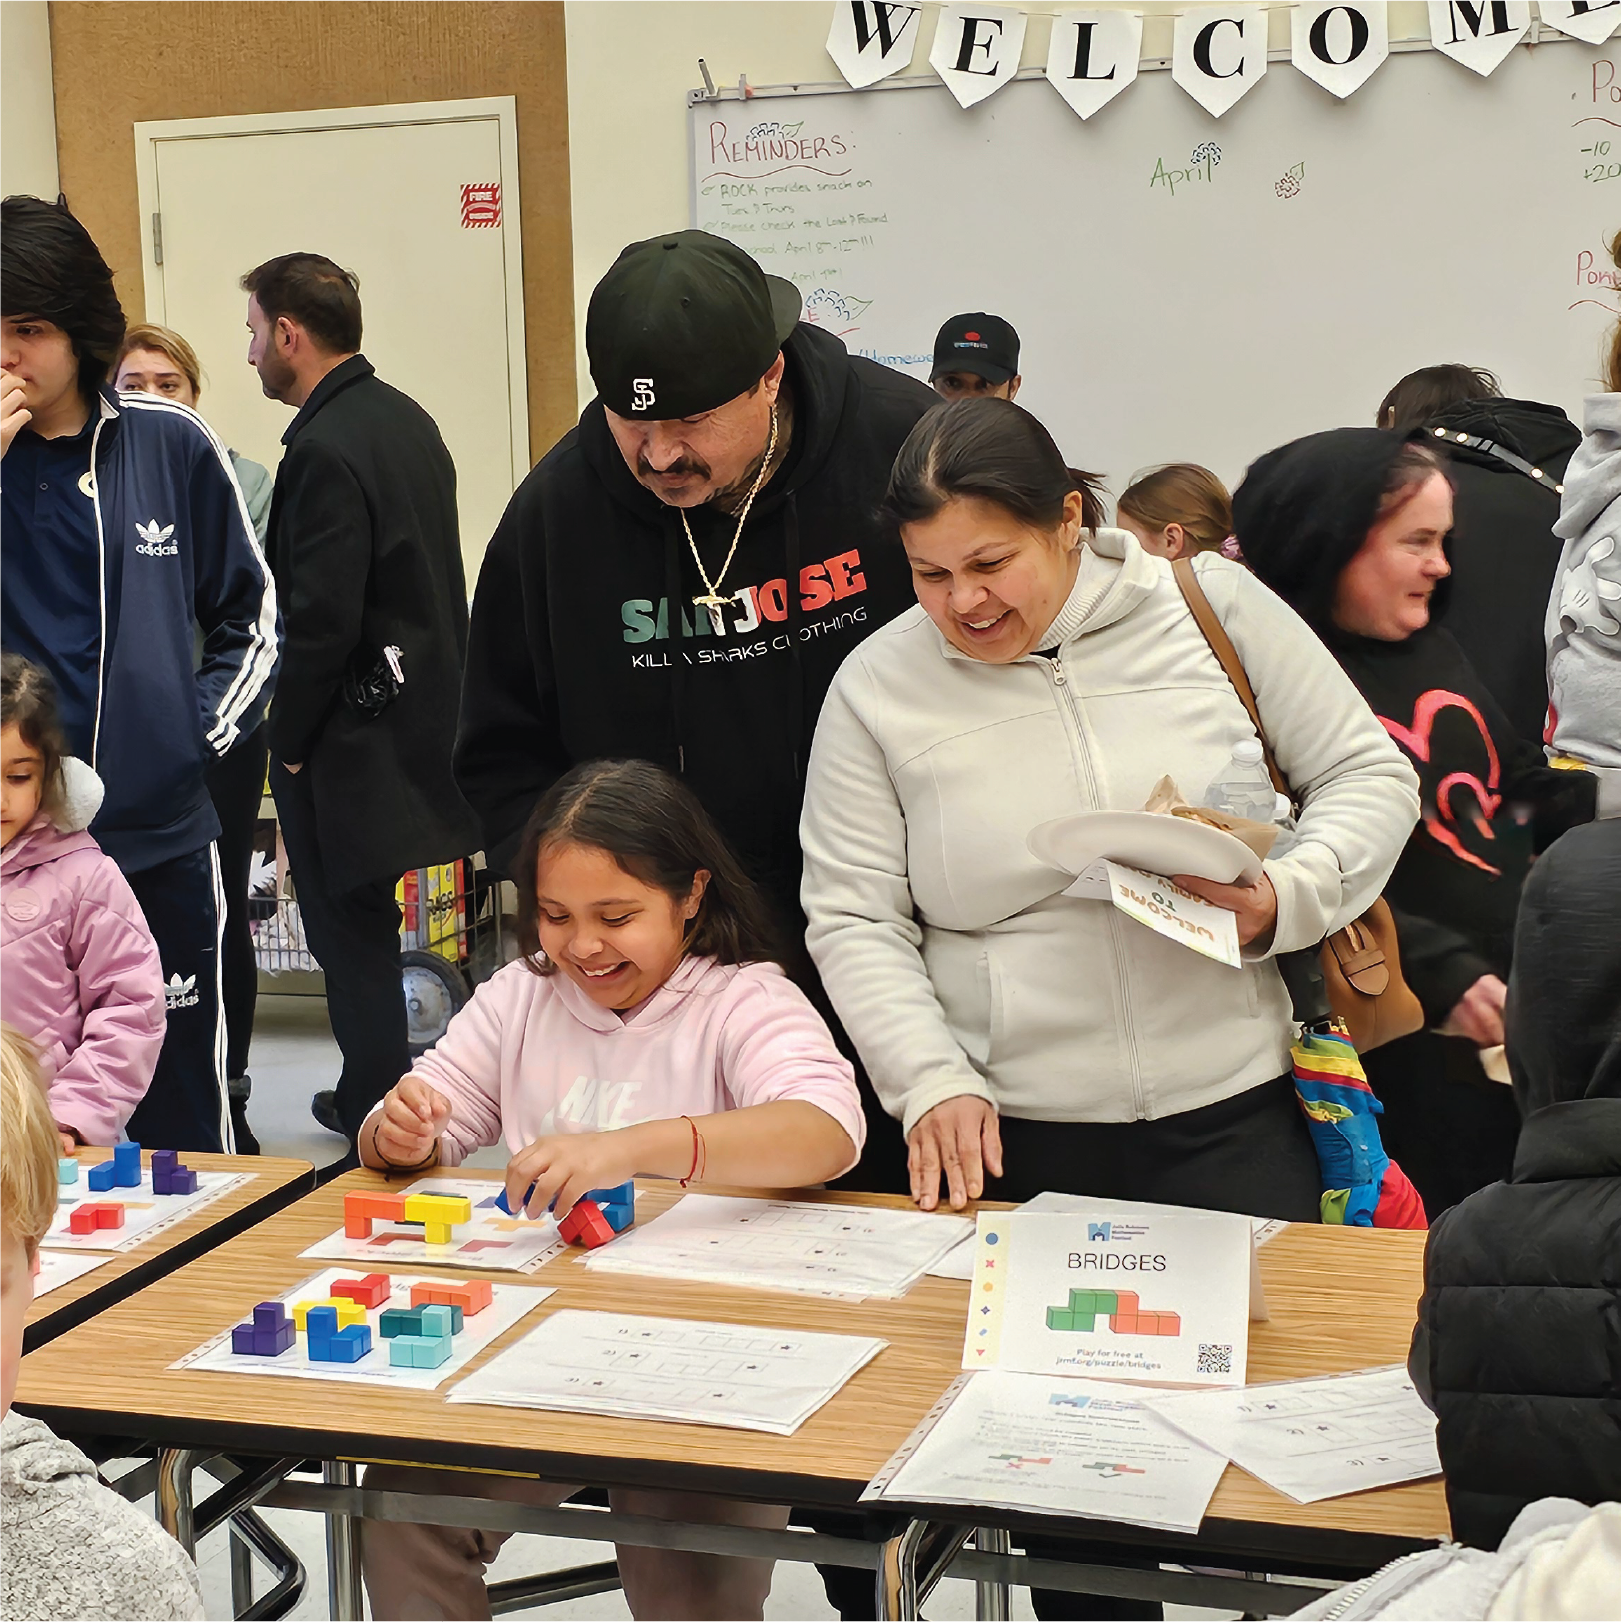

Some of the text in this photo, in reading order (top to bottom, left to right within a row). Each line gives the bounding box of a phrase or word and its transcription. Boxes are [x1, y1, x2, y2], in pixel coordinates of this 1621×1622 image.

[1580, 140, 1611, 157] -10
[1150, 153, 1213, 196] April
[720, 179, 873, 199] ROCK provides snack on
[856, 212, 889, 224] Found
[135, 542, 179, 557] adidas
[735, 549, 868, 634] JOSE
[165, 994, 199, 1010] didas
[1067, 1252, 1167, 1272] BRIDGES
[1076, 1348, 1144, 1359] Play for free at
